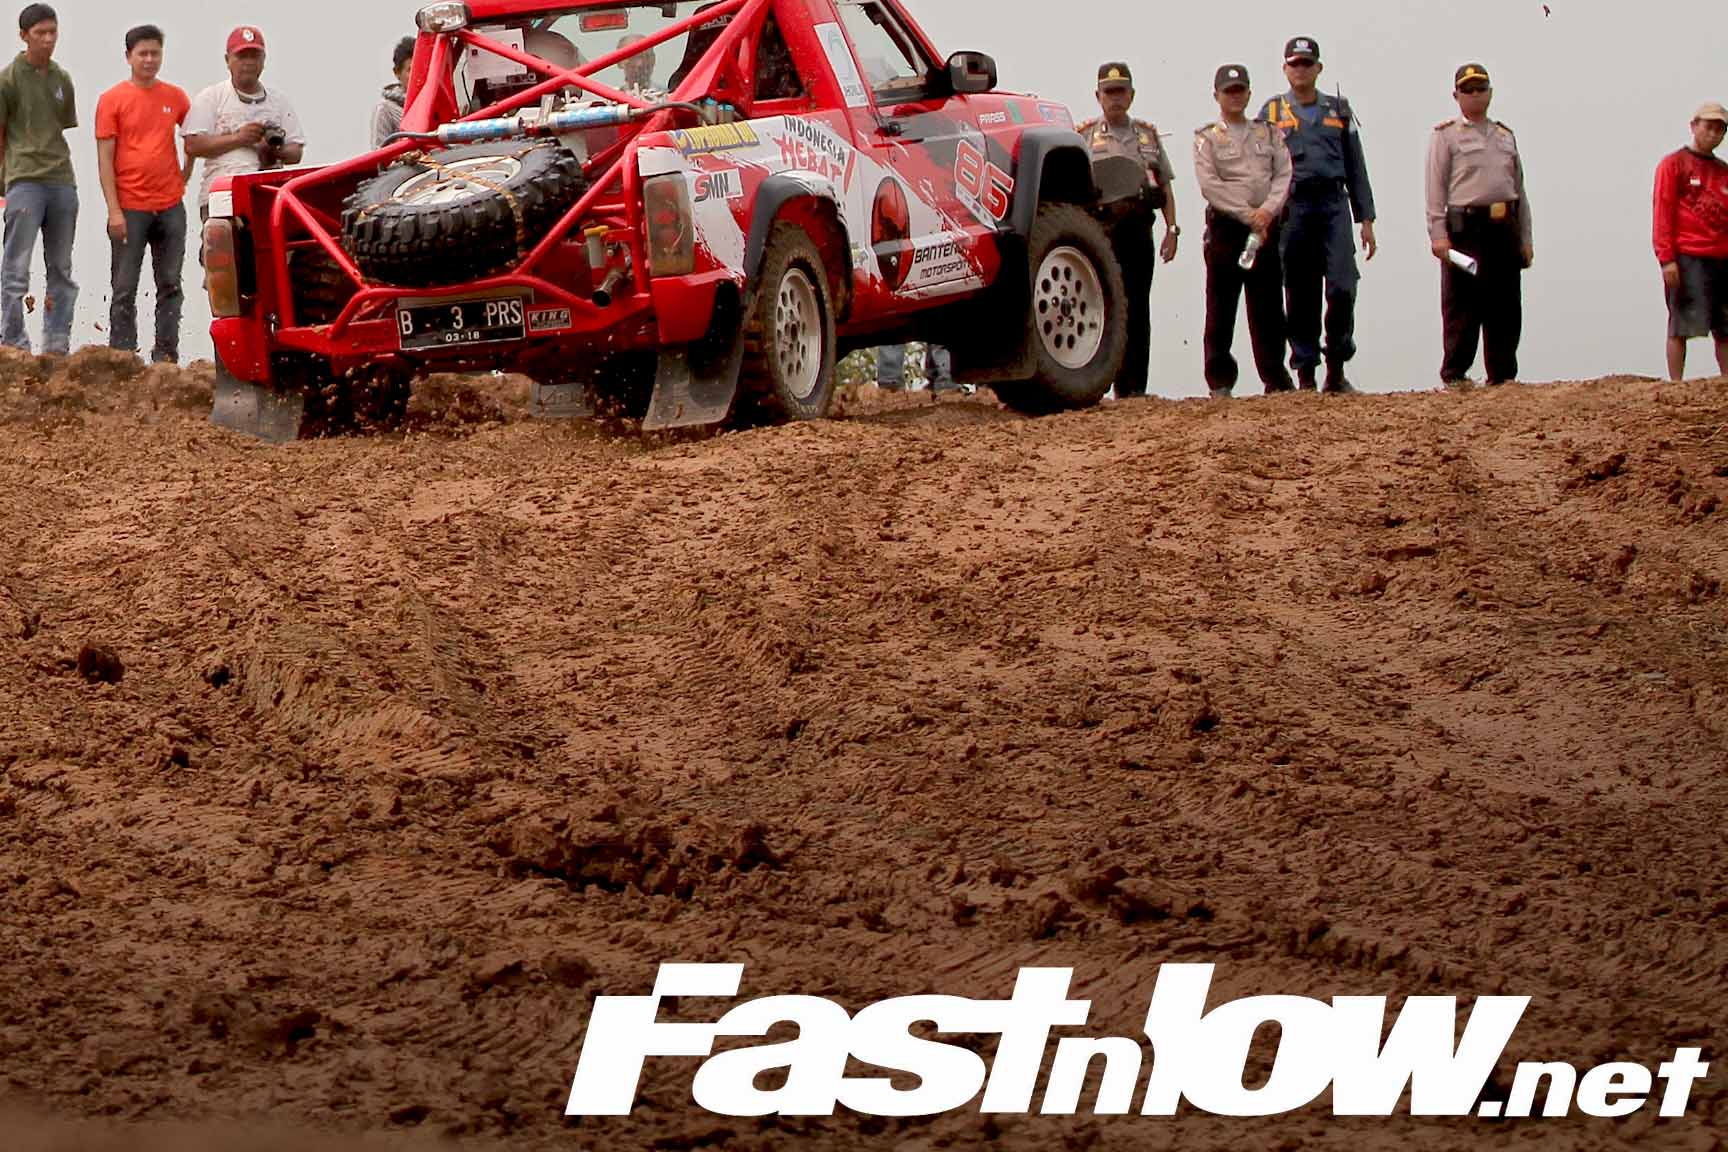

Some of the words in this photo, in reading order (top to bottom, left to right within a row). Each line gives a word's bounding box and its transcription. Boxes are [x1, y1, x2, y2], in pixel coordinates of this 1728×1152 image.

[784, 116, 845, 167] INDONESIA
[694, 172, 729, 202] SMN
[954, 139, 1015, 222] 86
[400, 310, 413, 335] B
[450, 306, 464, 329] 3
[486, 300, 522, 326] PRS
